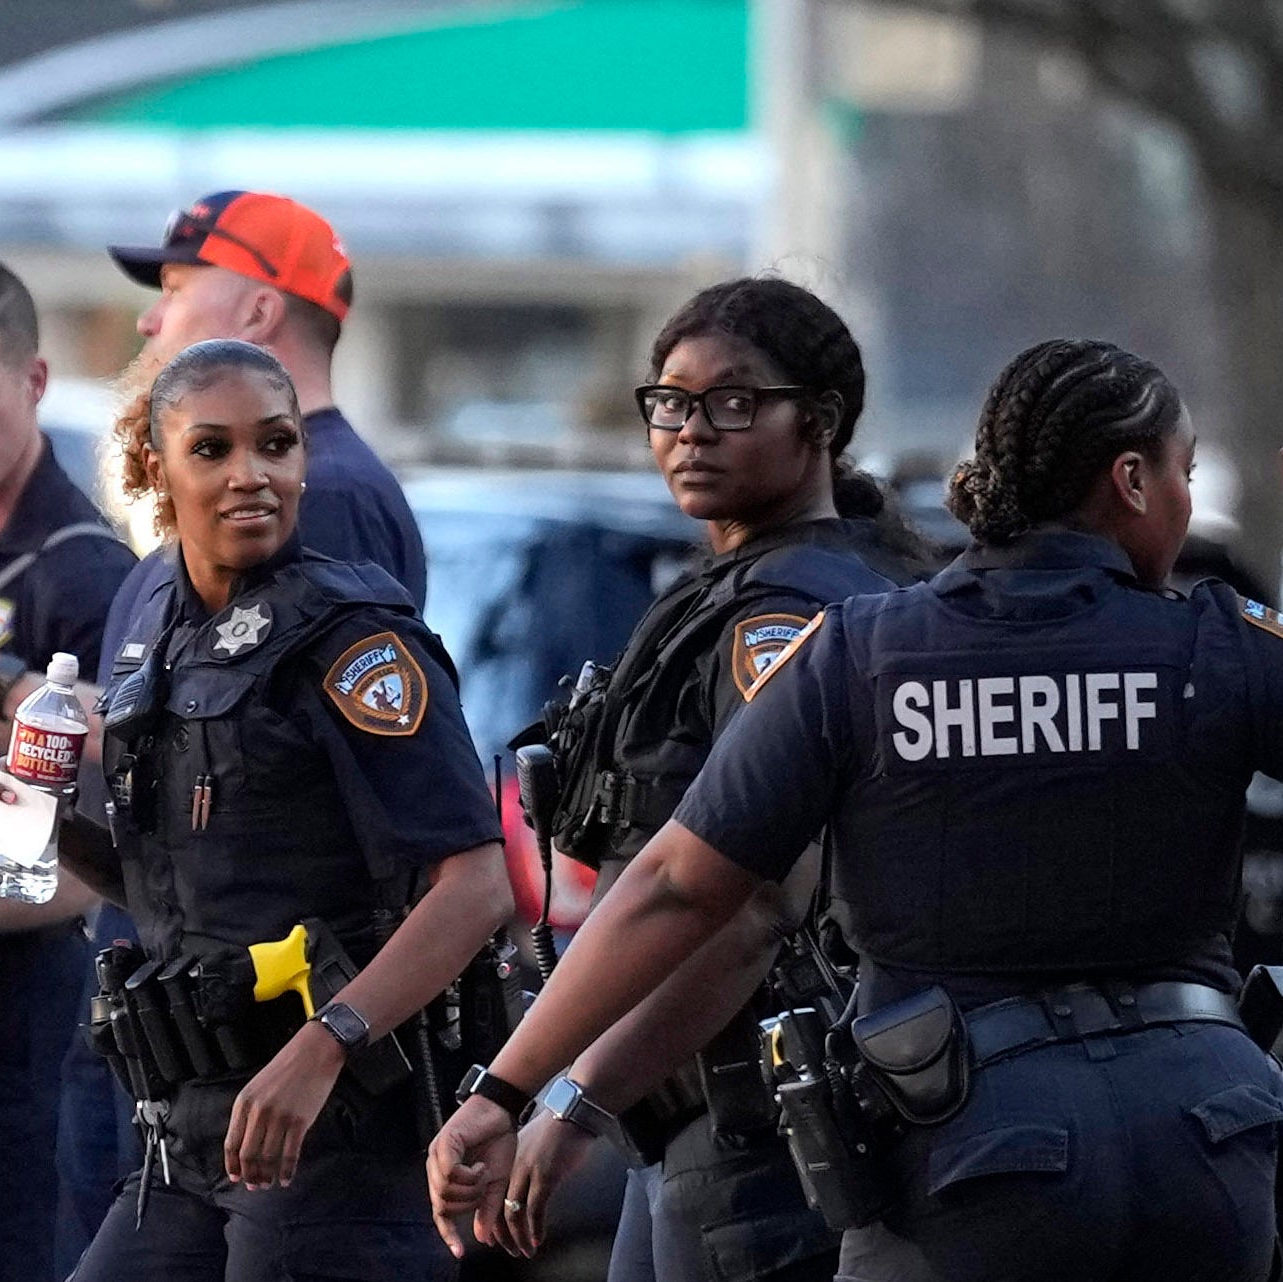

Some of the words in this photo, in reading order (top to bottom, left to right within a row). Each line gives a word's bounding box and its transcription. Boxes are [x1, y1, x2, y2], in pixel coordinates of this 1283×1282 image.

[759, 627, 799, 639] SHERIFF
[346, 650, 380, 680] SHERIFF
[892, 672, 1158, 762] SHERIFF
[36, 732, 45, 746] A
[19, 741, 71, 763] RECYCLED
[17, 754, 56, 774] BOTTLE
